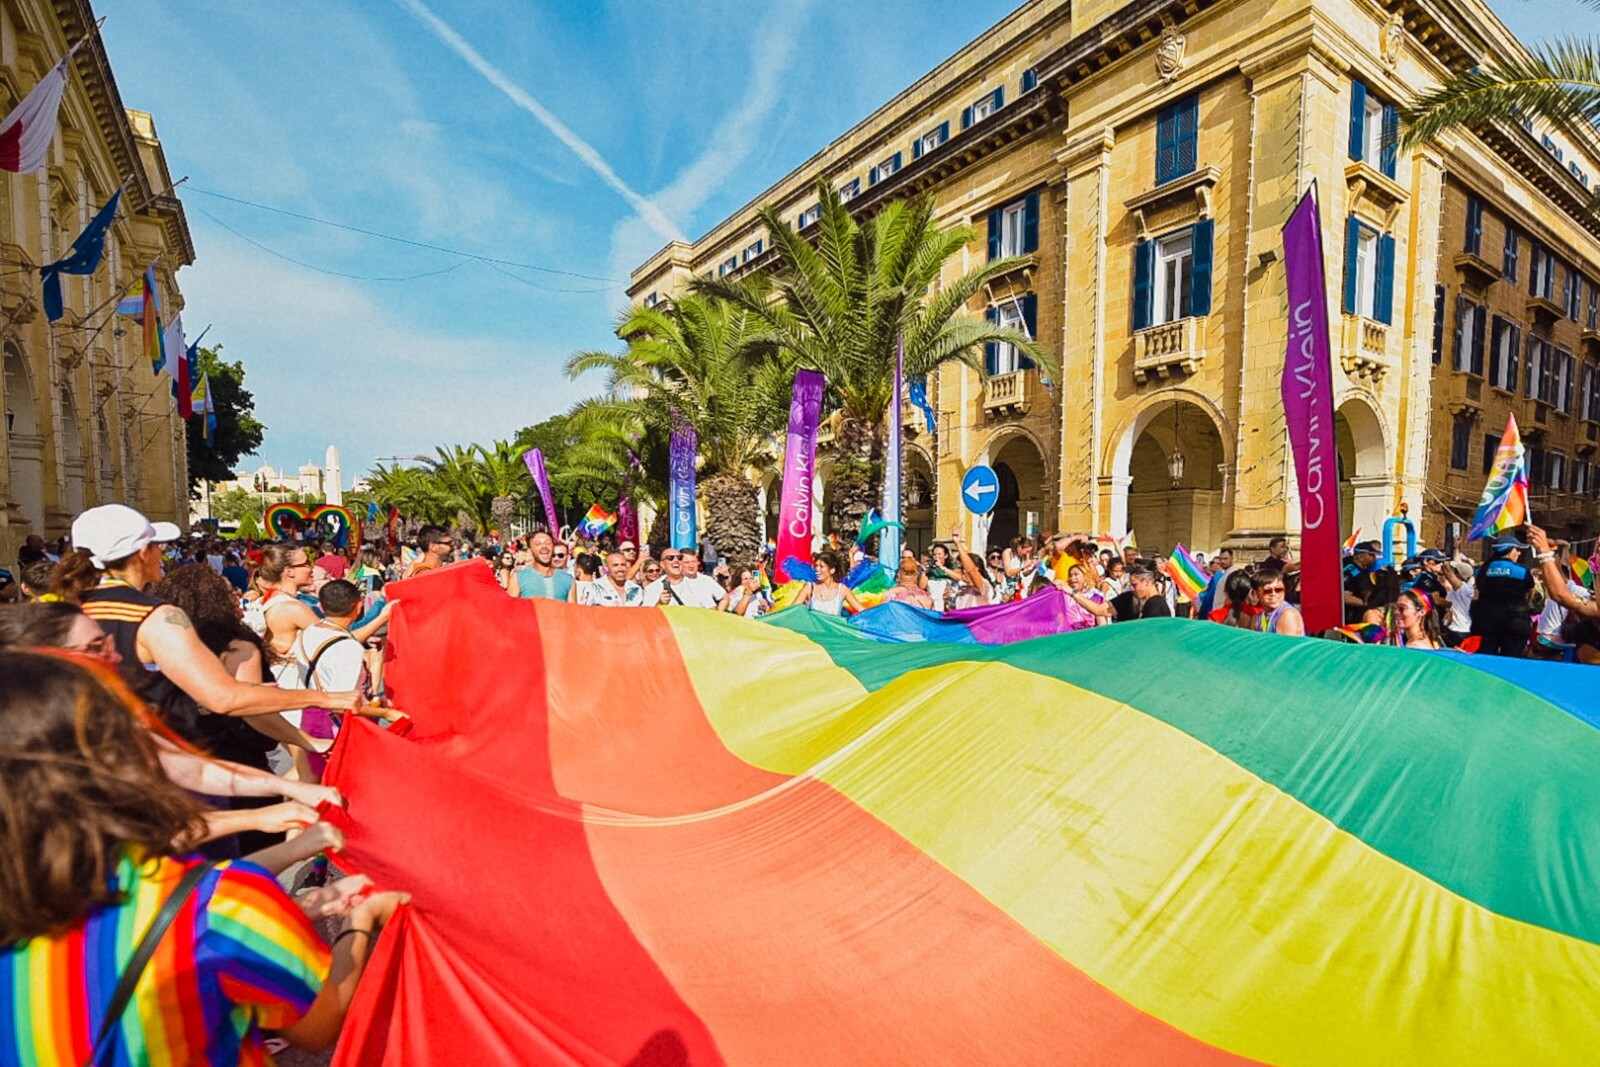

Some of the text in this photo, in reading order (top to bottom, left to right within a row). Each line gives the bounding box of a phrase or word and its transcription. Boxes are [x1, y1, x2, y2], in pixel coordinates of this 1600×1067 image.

[676, 486, 691, 535] Calvin
[789, 425, 810, 538] Calvin Klein
